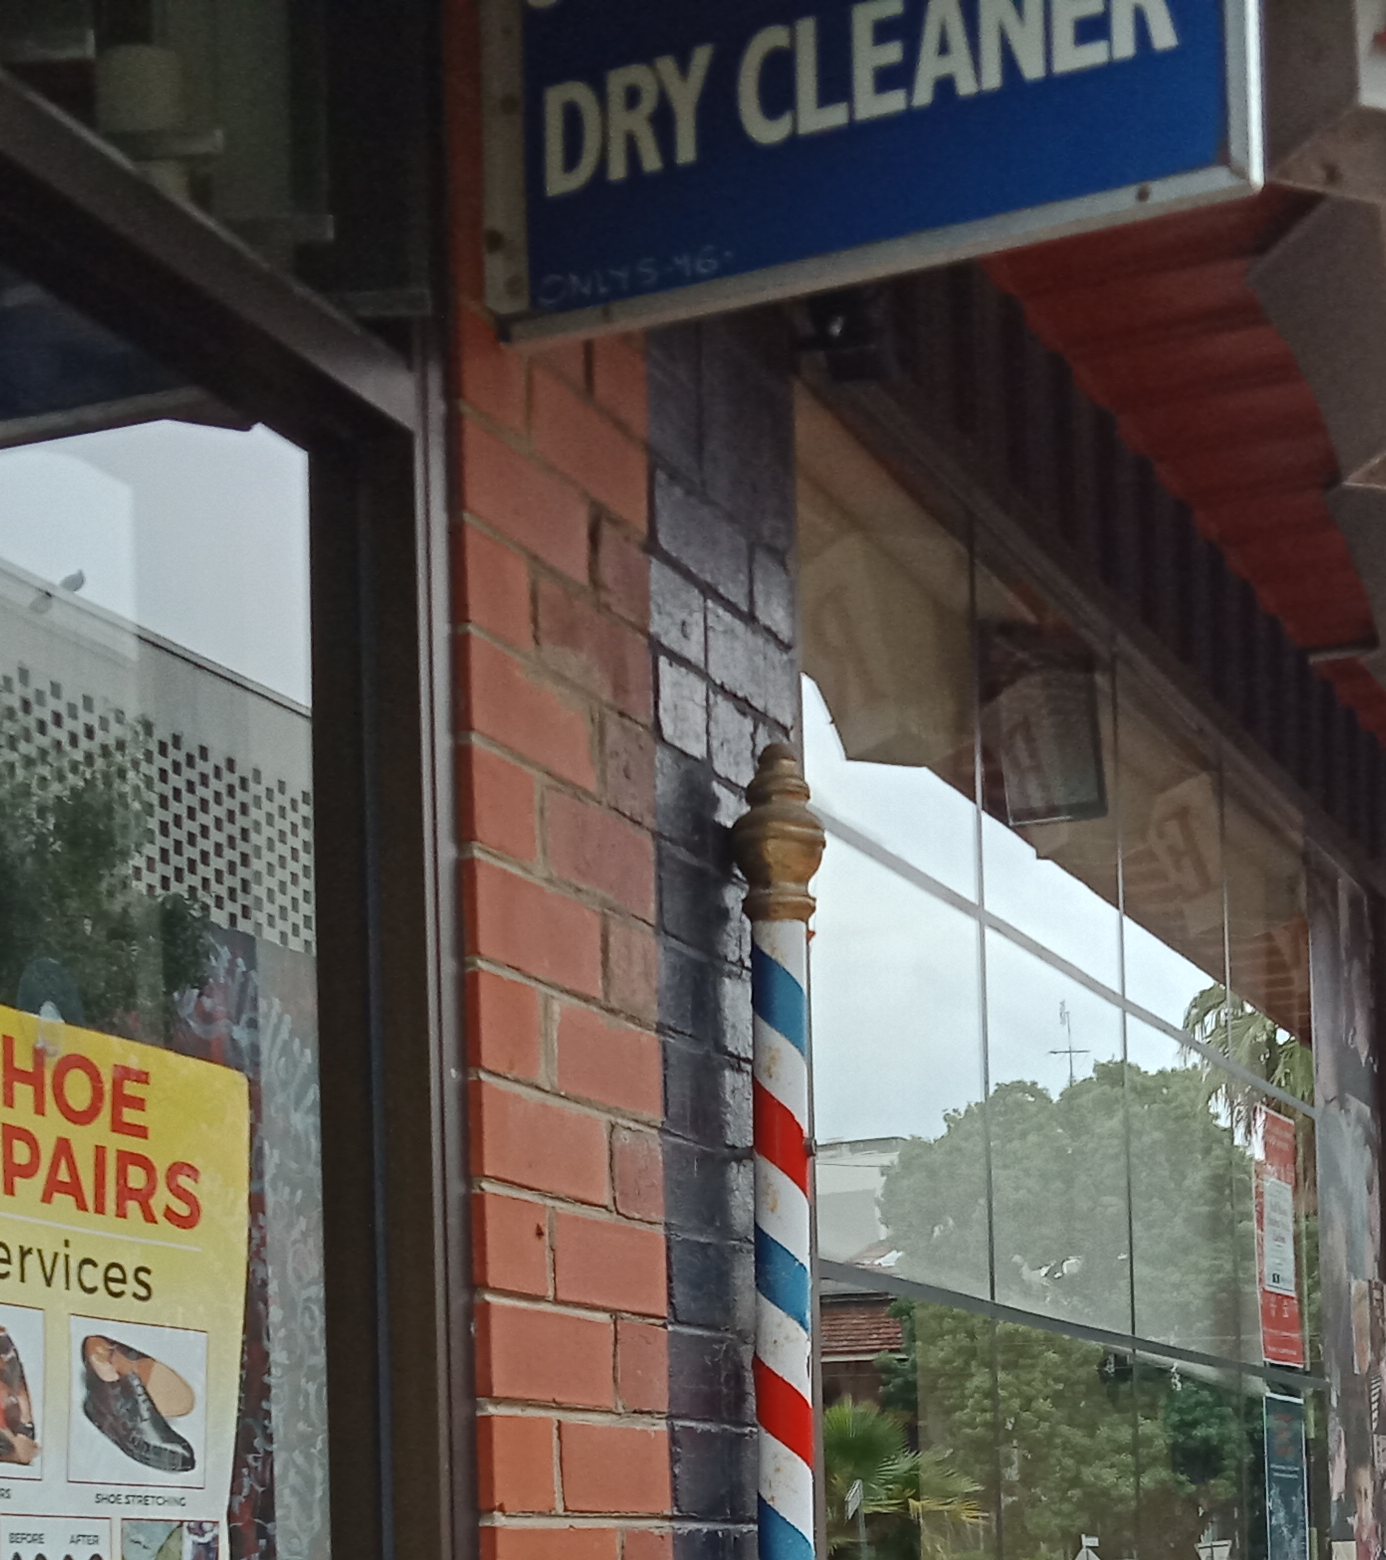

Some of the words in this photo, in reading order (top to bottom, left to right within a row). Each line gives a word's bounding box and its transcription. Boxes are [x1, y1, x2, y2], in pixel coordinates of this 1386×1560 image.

[544, 42, 715, 197] DRY
[95, 1493, 122, 1505] SHOE
[124, 1494, 187, 1507] STRETCHING
[8, 1532, 45, 1546] BEFORE
[69, 1533, 100, 1546] AFTER
